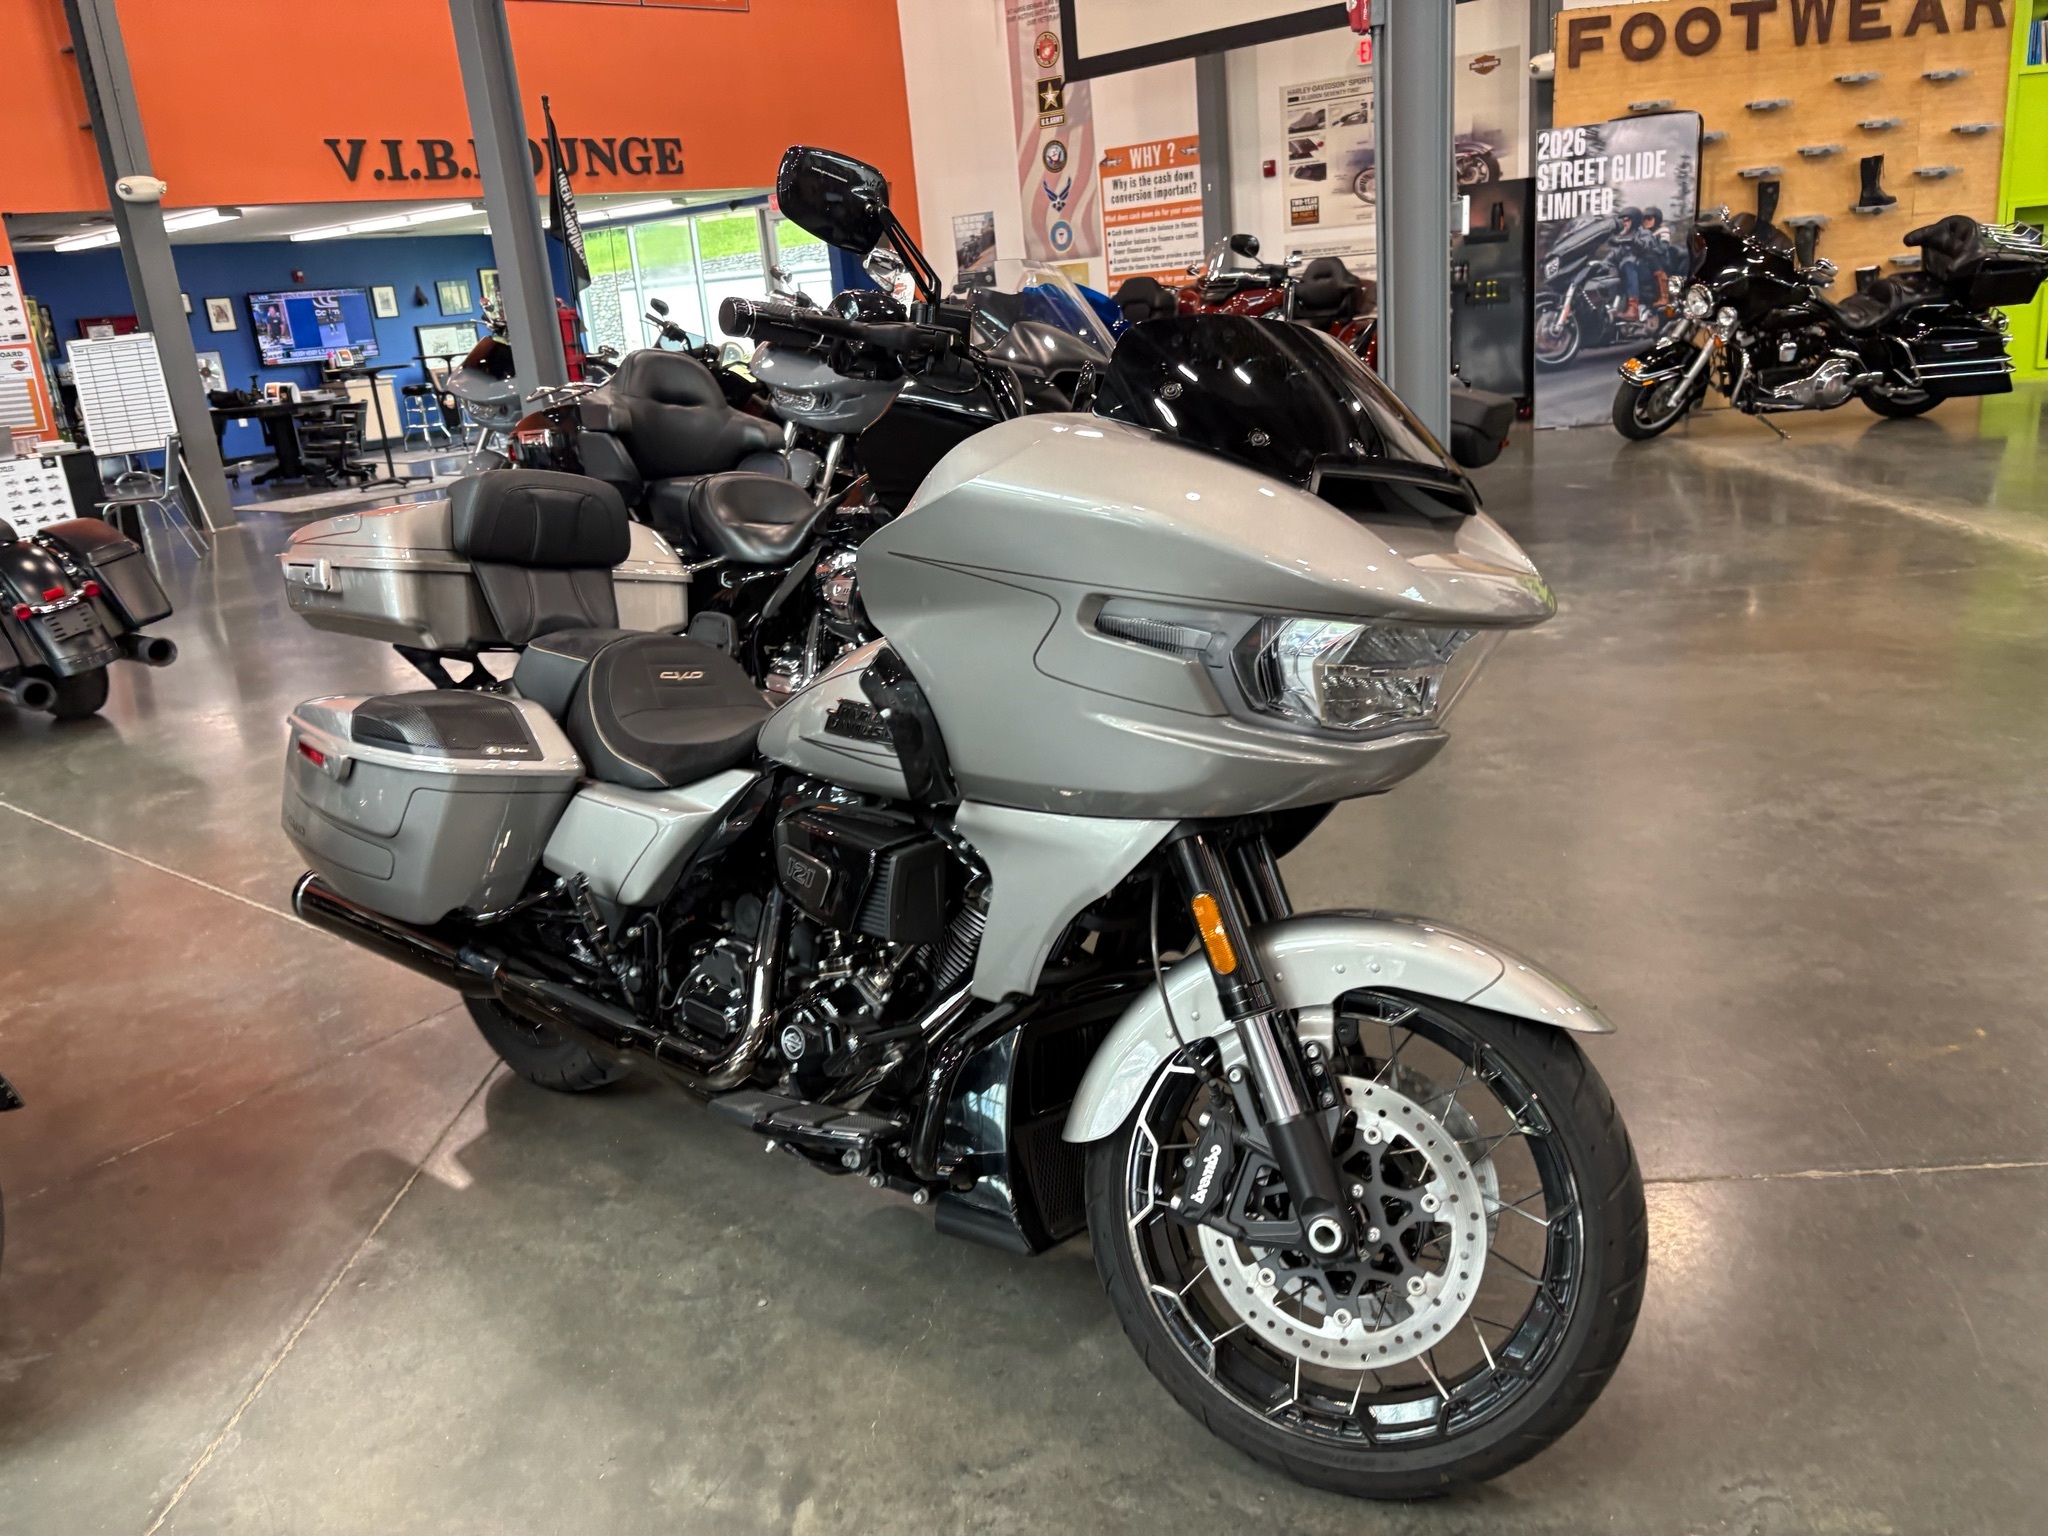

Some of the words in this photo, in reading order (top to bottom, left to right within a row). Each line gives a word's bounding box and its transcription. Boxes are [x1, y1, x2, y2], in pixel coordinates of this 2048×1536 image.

[1567, 0, 2007, 69] FOOTWEAR
[323, 138, 472, 182] V.I.B.
[1129, 144, 1161, 170] WHY
[1166, 141, 1176, 164] ?
[1537, 127, 1587, 161] 2026
[1111, 178, 1127, 192] Why
[1129, 176, 1137, 188] is
[1138, 175, 1151, 187] the
[1153, 172, 1172, 185] cash
[1174, 169, 1194, 181] down
[1537, 156, 1608, 192] STREET
[1611, 149, 1667, 183] GLIDE
[1110, 189, 1152, 205] conversion
[1153, 181, 1198, 201] important?
[1537, 187, 1614, 222] LIMITED
[786, 856, 817, 888] 121
[1189, 1143, 1222, 1205] brembo
